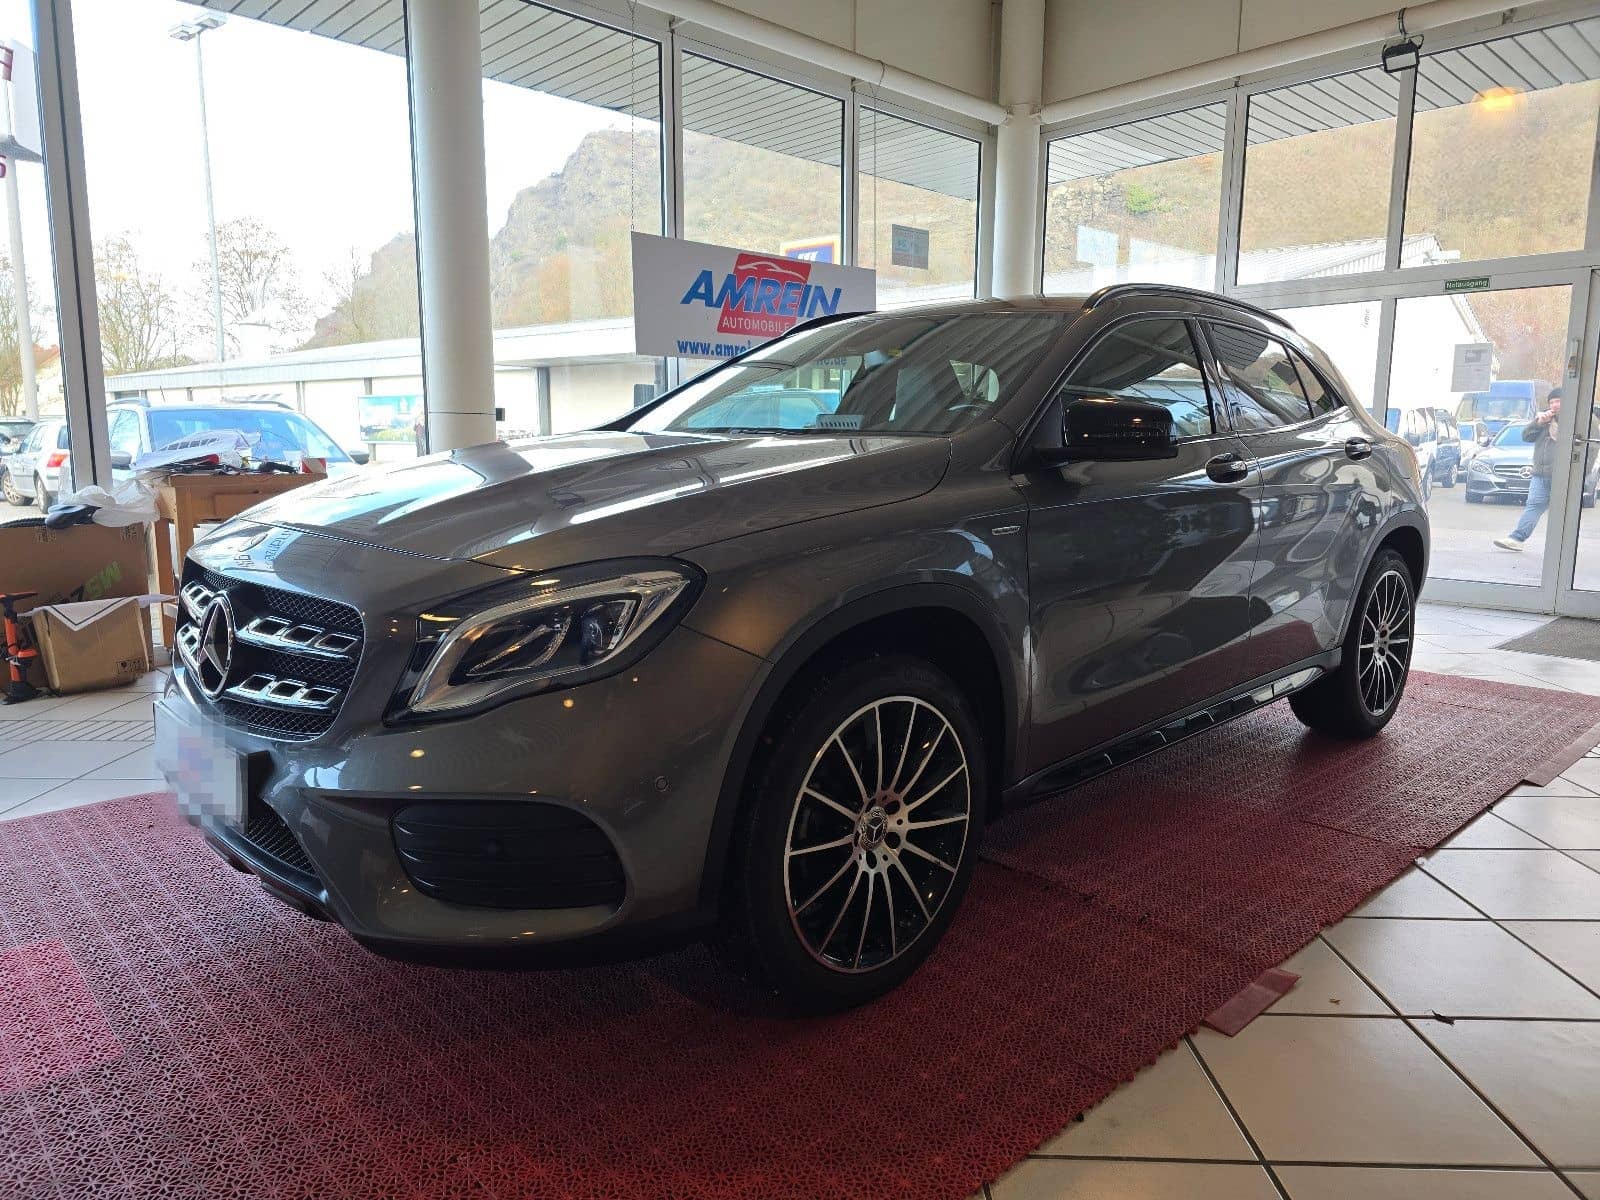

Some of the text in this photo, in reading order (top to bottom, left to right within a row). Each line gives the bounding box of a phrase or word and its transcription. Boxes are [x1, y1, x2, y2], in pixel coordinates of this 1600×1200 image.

[1446, 280, 1488, 289] Notausgang
[680, 269, 842, 319] AMREIN
[722, 316, 790, 333] AUTOMOBILE
